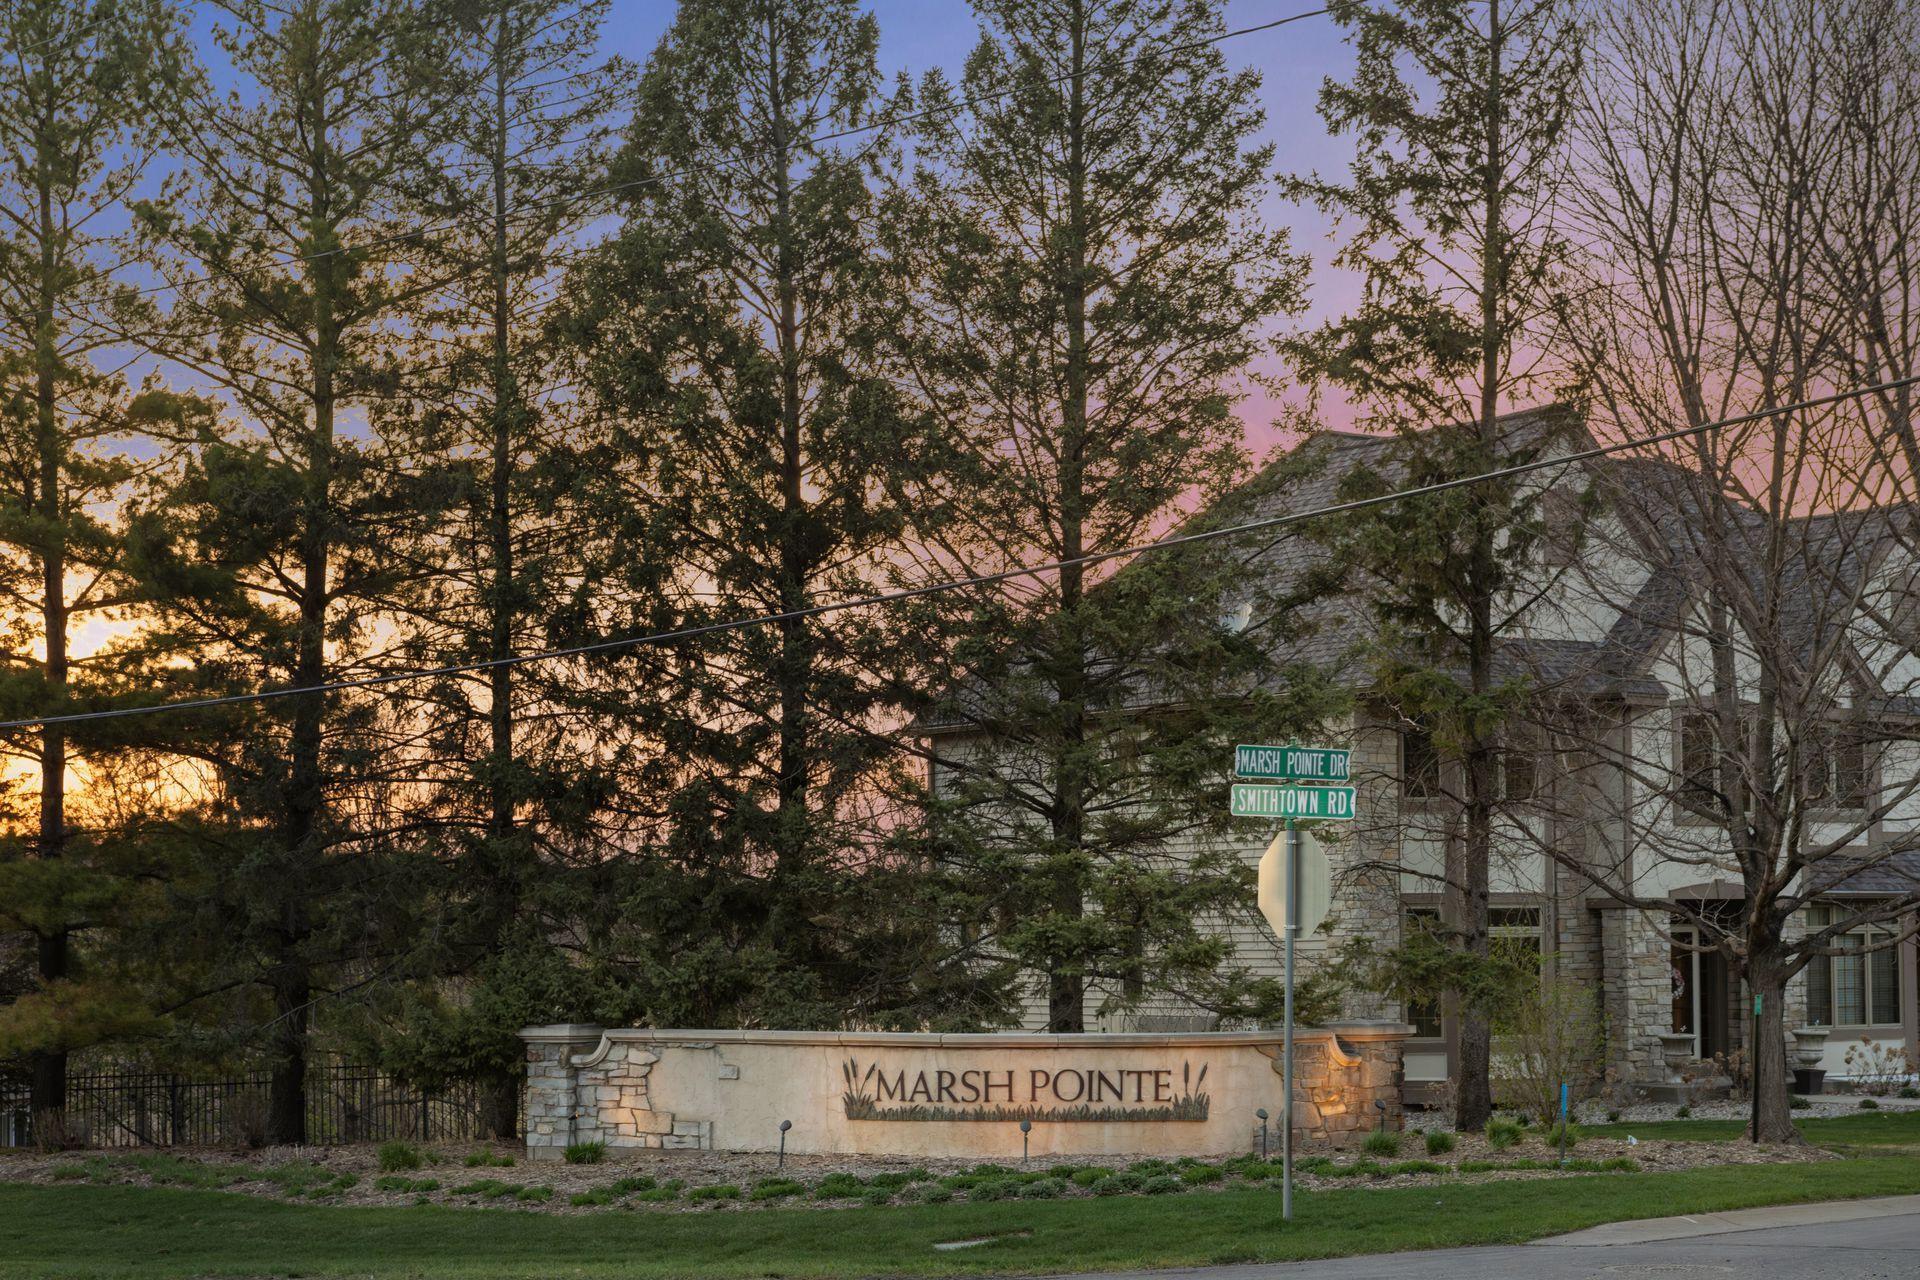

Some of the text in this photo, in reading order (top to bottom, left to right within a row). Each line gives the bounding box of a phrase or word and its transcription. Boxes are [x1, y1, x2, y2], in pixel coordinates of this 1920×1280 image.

[1240, 750, 1345, 776] MARSH POINTE DR
[1238, 789, 1347, 815] SMITHTOWN RD
[875, 1069, 1173, 1103] MARSH POINTE
